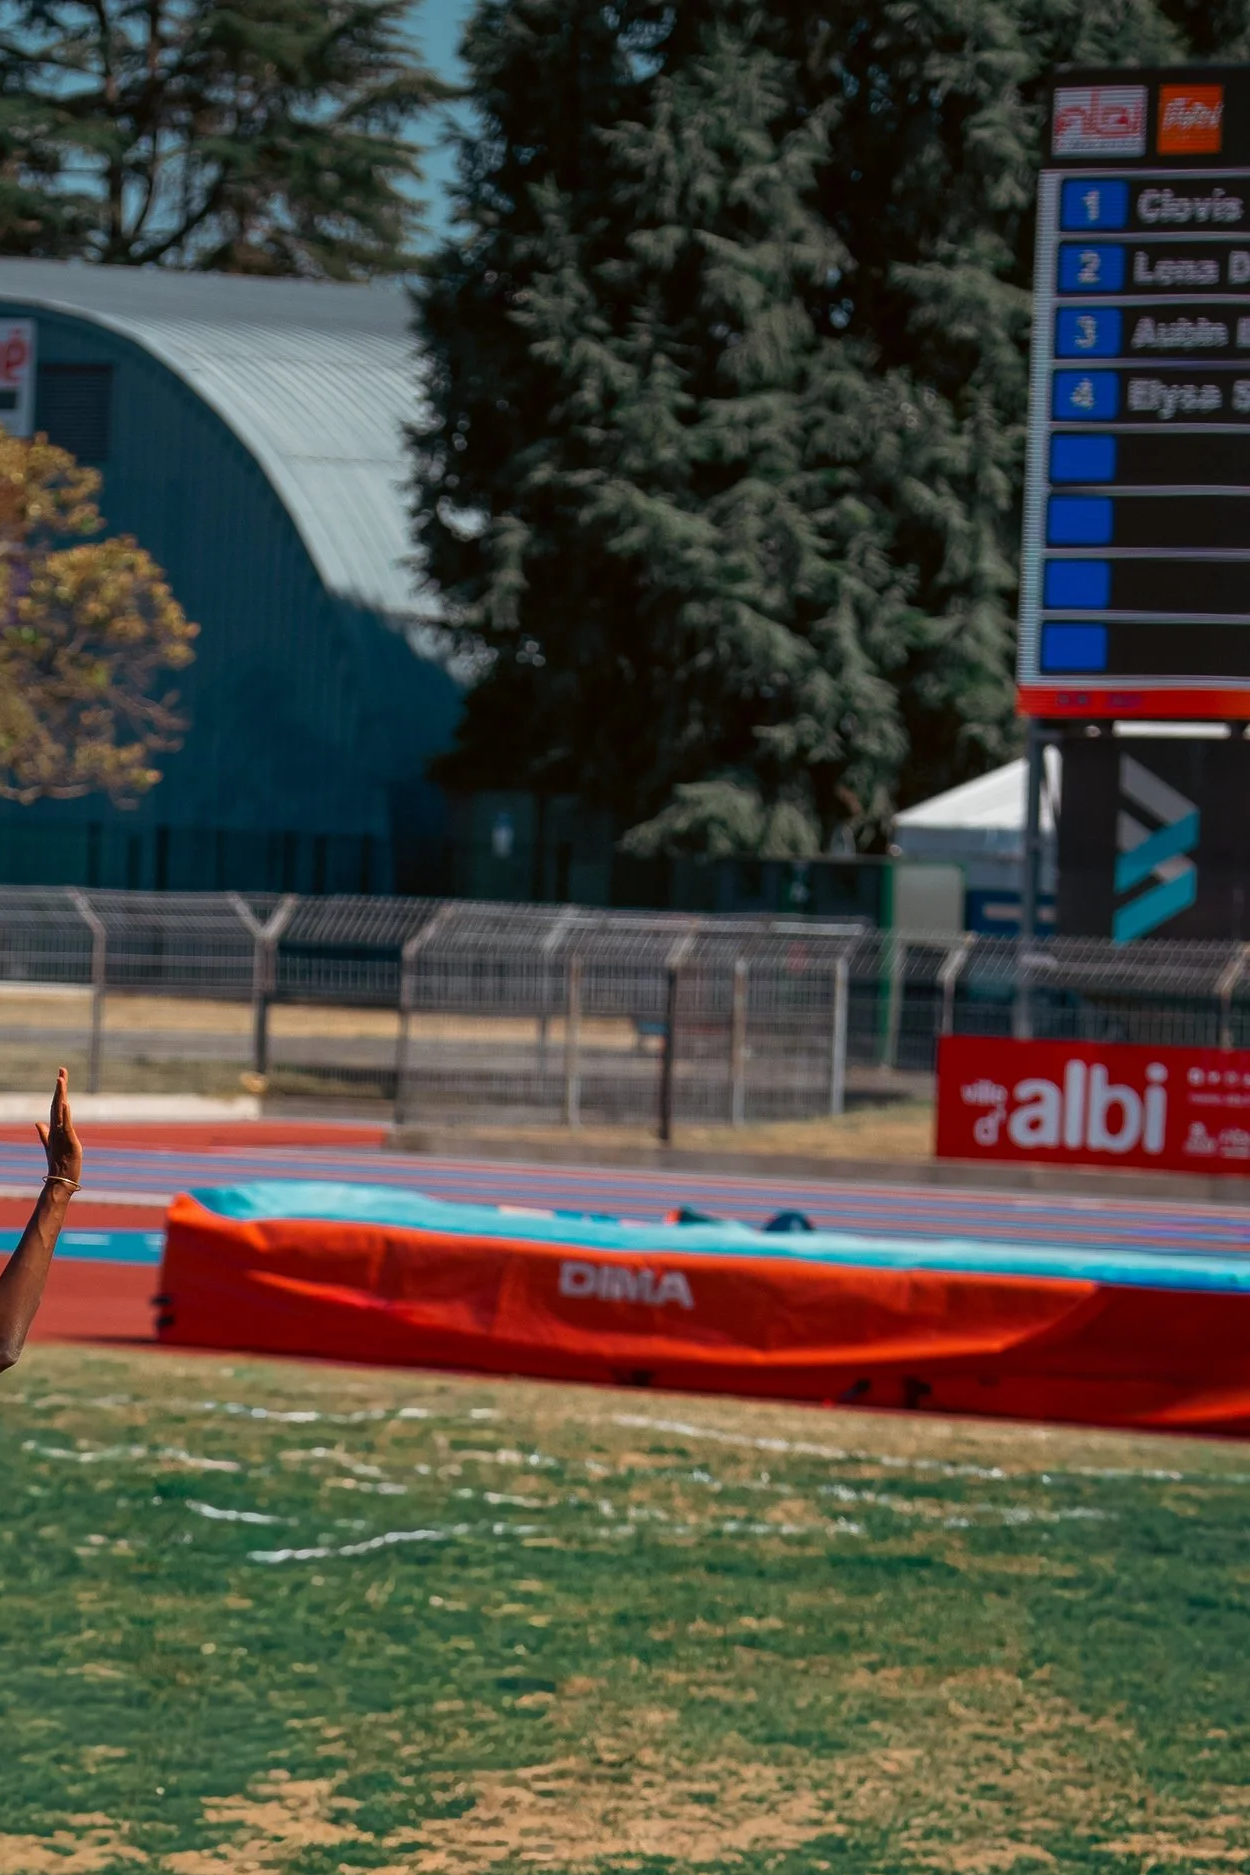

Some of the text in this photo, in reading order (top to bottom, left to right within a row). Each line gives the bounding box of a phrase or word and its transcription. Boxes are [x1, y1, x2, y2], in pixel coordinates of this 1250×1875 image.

[1081, 187, 1244, 223] 1 Clovis
[1078, 251, 1101, 284] 2
[1075, 316, 1096, 348] 3
[1071, 378, 1095, 410] 4
[1009, 1058, 1168, 1155] albi
[559, 1260, 695, 1310] DIMA
